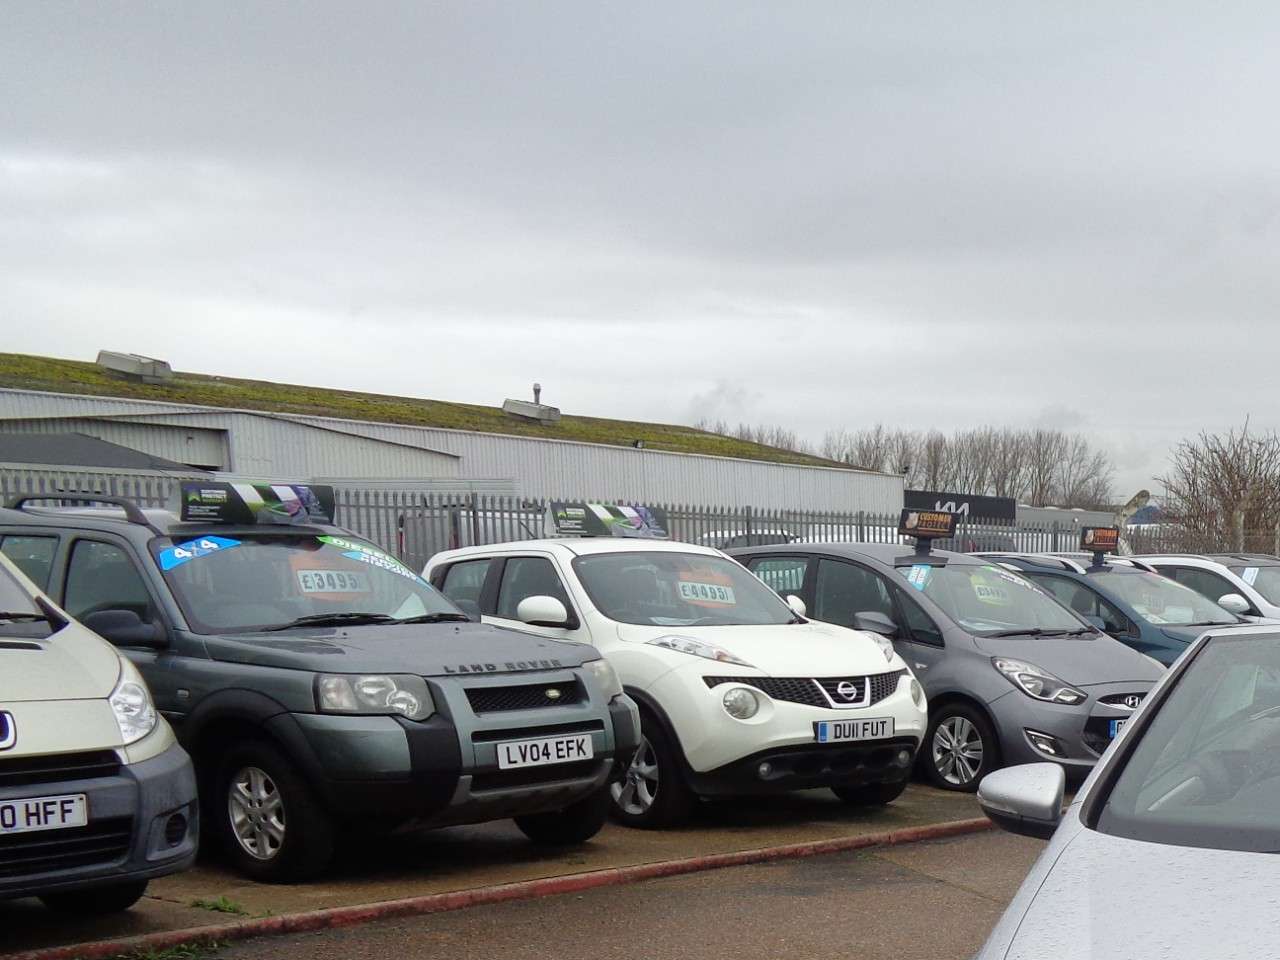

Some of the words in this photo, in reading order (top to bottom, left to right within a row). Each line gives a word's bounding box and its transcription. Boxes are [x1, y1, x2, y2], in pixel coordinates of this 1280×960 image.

[443, 663, 497, 673] LAND
[504, 659, 562, 671] ROVER
[862, 721, 887, 737] FUT
[506, 742, 551, 765] LV04
[556, 738, 587, 759] EFK
[25, 799, 75, 827] HFF
